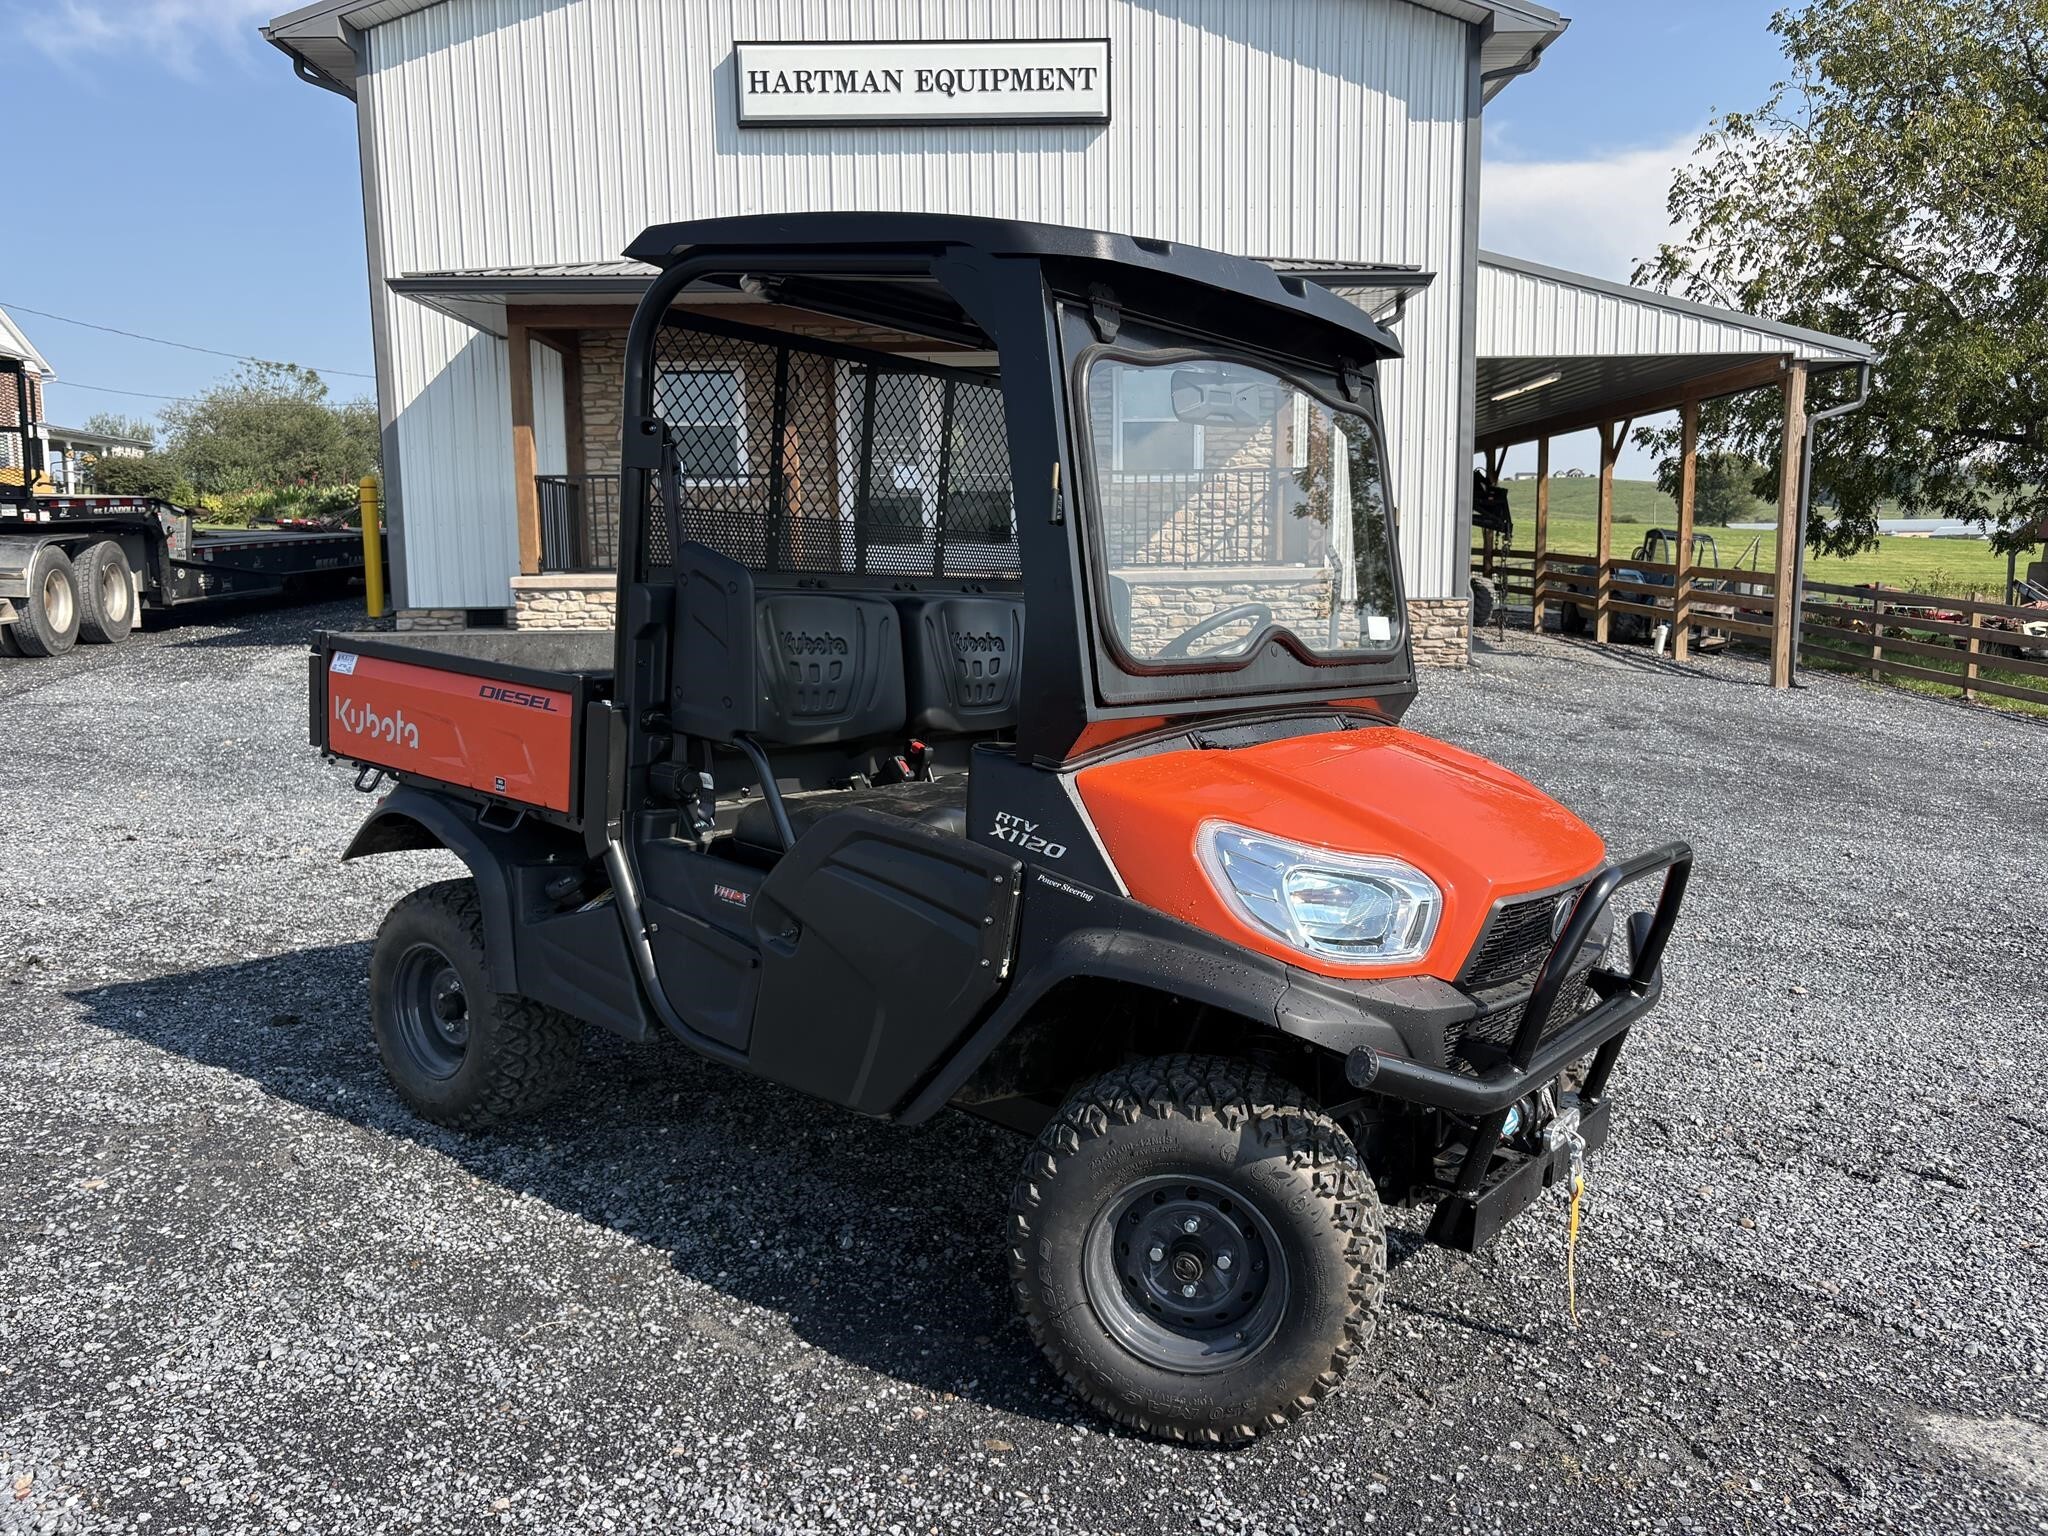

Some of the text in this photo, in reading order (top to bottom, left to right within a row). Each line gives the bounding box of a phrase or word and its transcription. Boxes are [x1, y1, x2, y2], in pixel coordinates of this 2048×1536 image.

[747, 67, 1097, 97] HARTMAN EQUIPMENT
[780, 632, 848, 655] Kubota
[951, 632, 1006, 652] Kubota
[479, 685, 558, 712] DIESEL
[335, 695, 419, 749] Kubota
[995, 811, 1040, 833] RTV
[988, 823, 1067, 859] X1120
[1037, 874, 1094, 902] Power Steering
